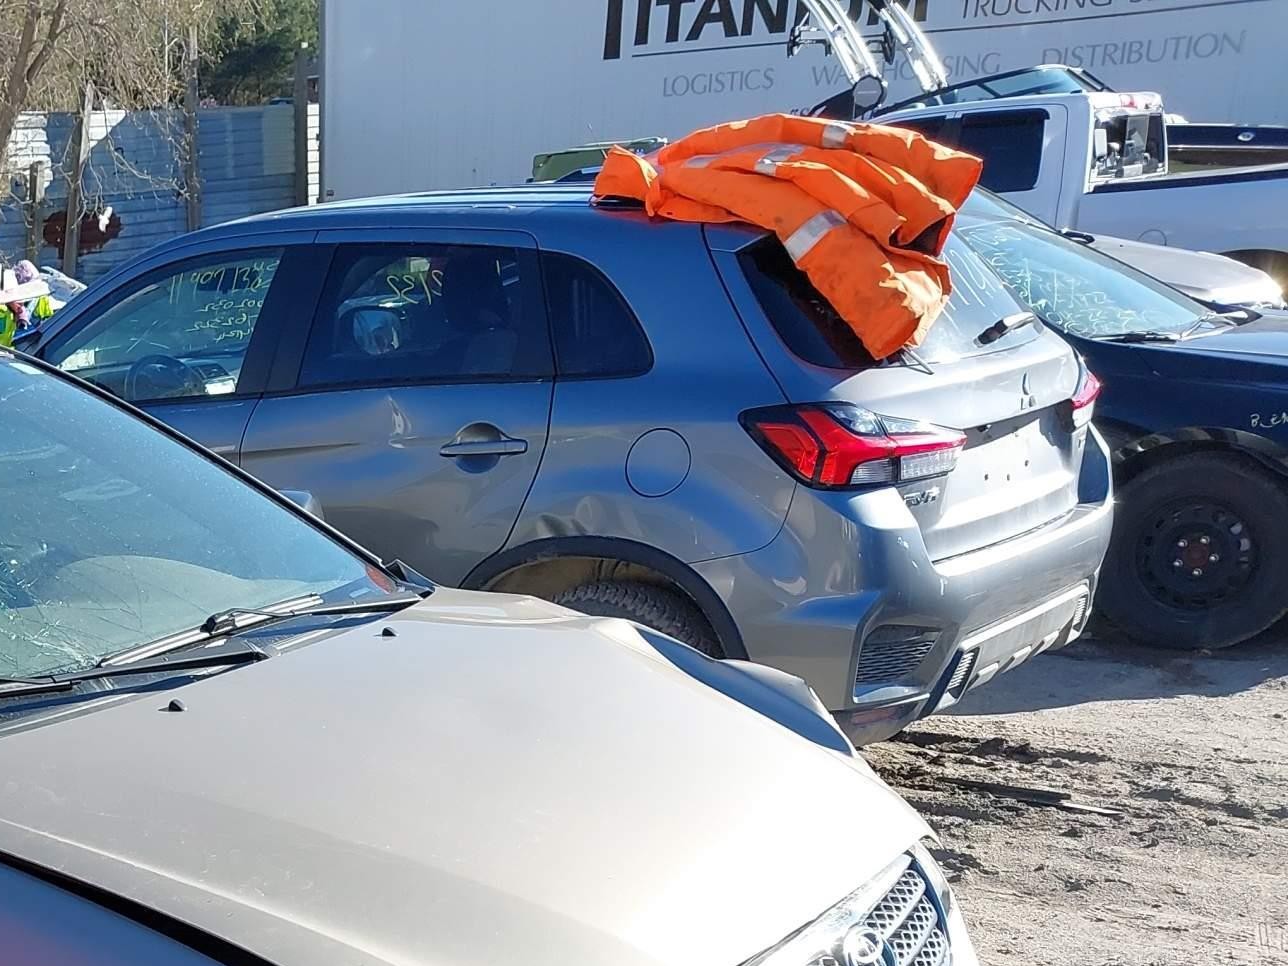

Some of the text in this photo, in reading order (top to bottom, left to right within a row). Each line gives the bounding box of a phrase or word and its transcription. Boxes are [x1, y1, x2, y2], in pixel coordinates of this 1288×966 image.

[662, 29, 1249, 98] LOGISTICS WAHOSING DISTRIBUTION
